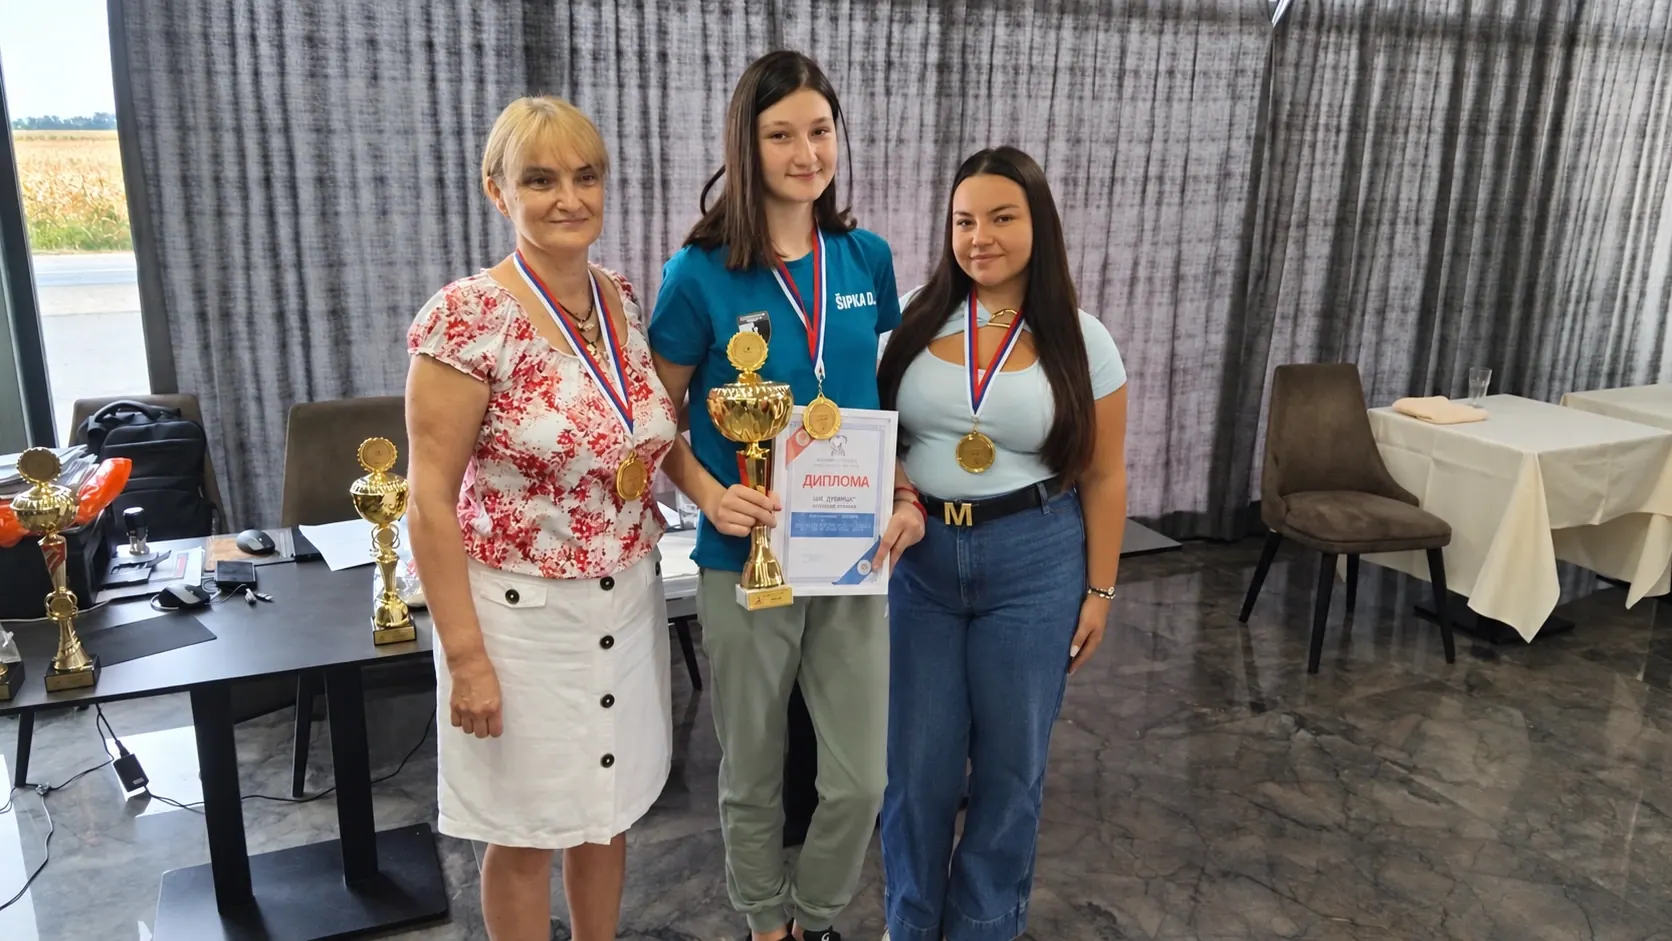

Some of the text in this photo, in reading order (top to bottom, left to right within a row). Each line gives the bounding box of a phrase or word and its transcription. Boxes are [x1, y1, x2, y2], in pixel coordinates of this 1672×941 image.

[835, 291, 877, 310] ŠIPKA D.
[802, 474, 870, 489] ДИПЛОМА
[944, 502, 973, 527] M
